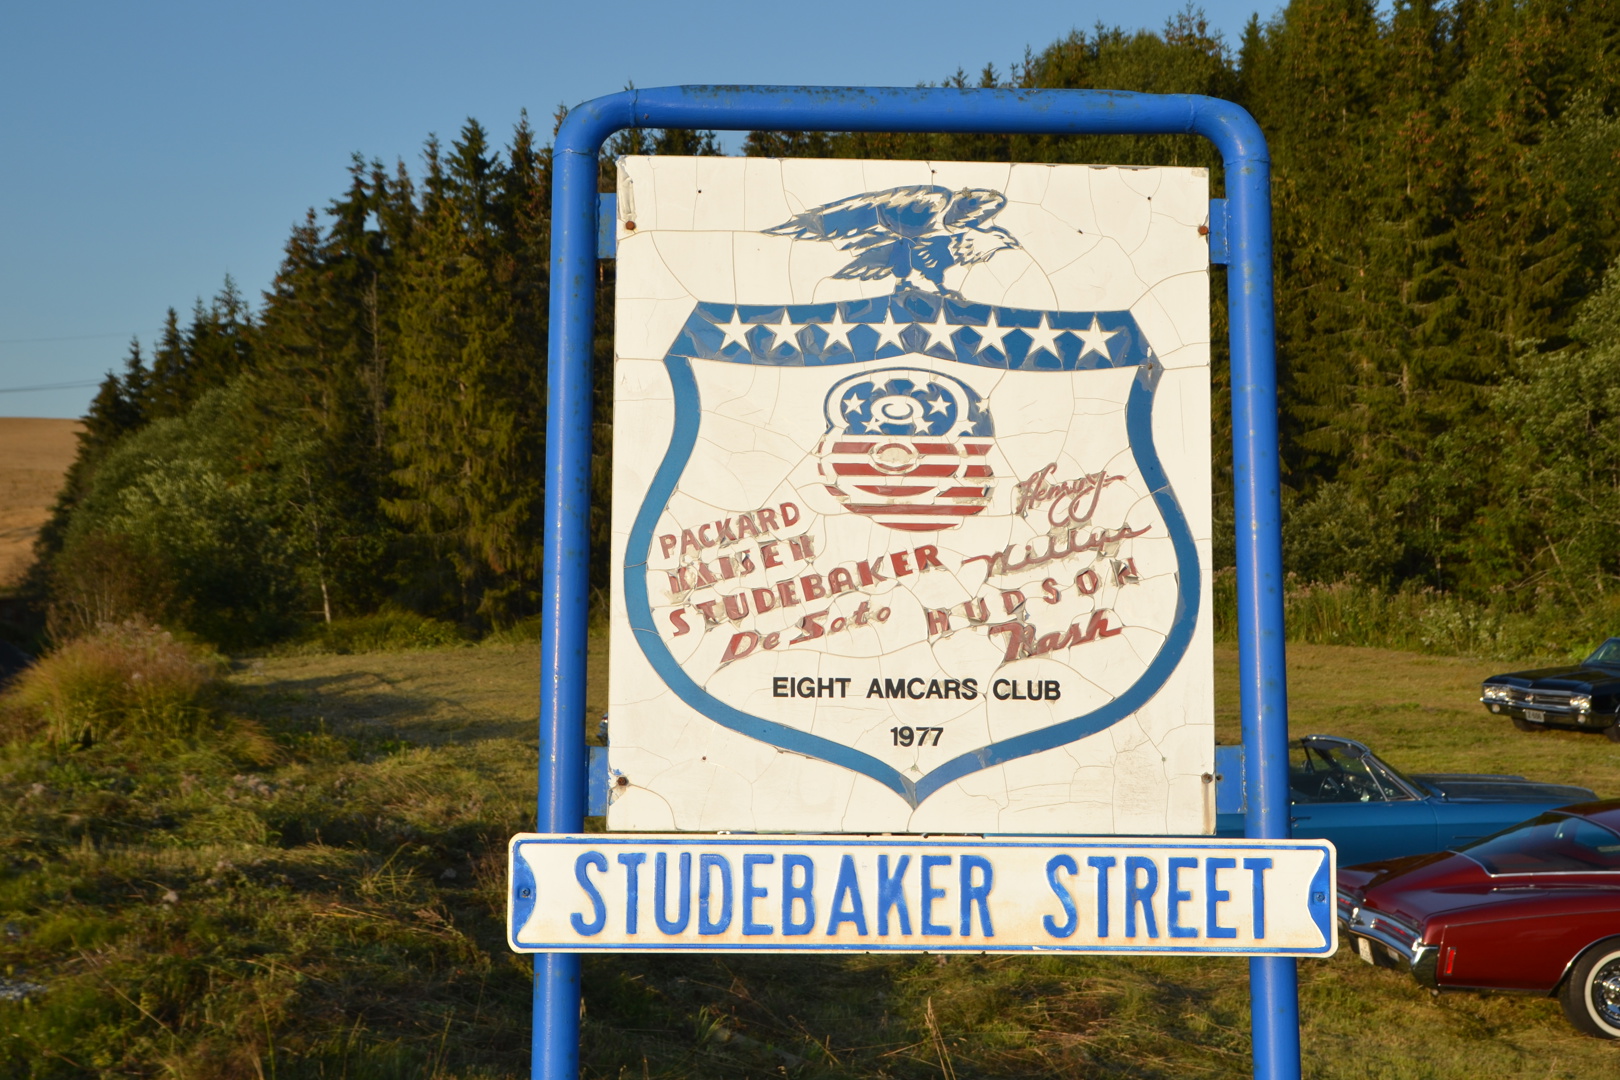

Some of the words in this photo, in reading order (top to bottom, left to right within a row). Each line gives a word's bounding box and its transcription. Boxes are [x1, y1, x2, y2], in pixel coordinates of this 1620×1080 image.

[659, 502, 800, 559] PACKARD
[667, 534, 815, 594] KAISER
[669, 545, 943, 637] STUDEBAKER
[989, 608, 1122, 662] Nash
[772, 677, 851, 698] EIGHT
[866, 677, 978, 699] AMCARS
[993, 679, 1061, 700] CLUB
[890, 726, 944, 747] 1977
[570, 851, 994, 937] STUDEBAKER
[1043, 854, 1272, 939] STREET
